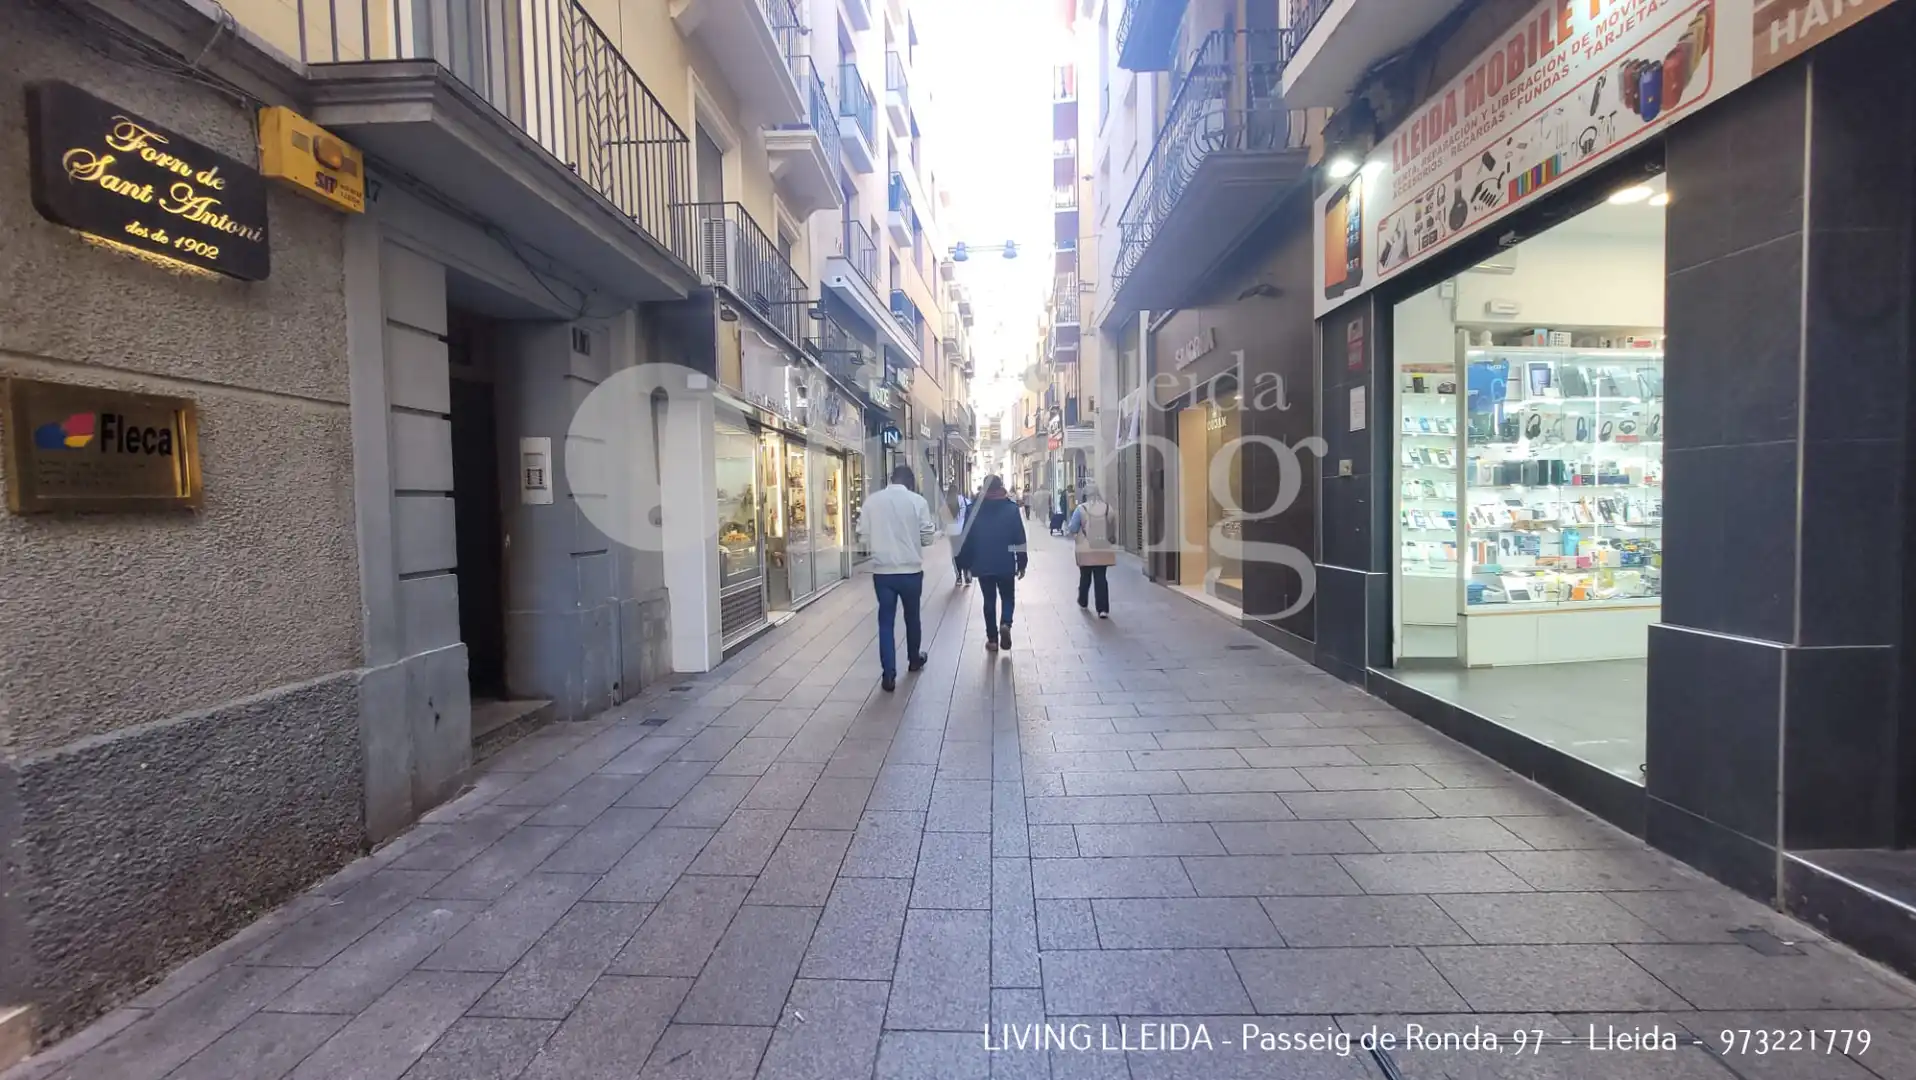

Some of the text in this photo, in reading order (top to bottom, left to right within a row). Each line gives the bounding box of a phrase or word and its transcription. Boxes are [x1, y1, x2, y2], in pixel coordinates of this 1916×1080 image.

[1393, 0, 1574, 174] LLEIDA MOBILE
[1451, 110, 1505, 157] RECARGAS
[1517, 64, 1569, 110] FUNDAS
[1480, 108, 1489, 122] Y
[1572, 32, 1590, 55] DE
[105, 114, 226, 190] Forn de
[62, 148, 264, 242] Sant Antoni
[174, 235, 220, 260] 1902
[101, 413, 172, 457] Fleca
[883, 431, 898, 445] IN
